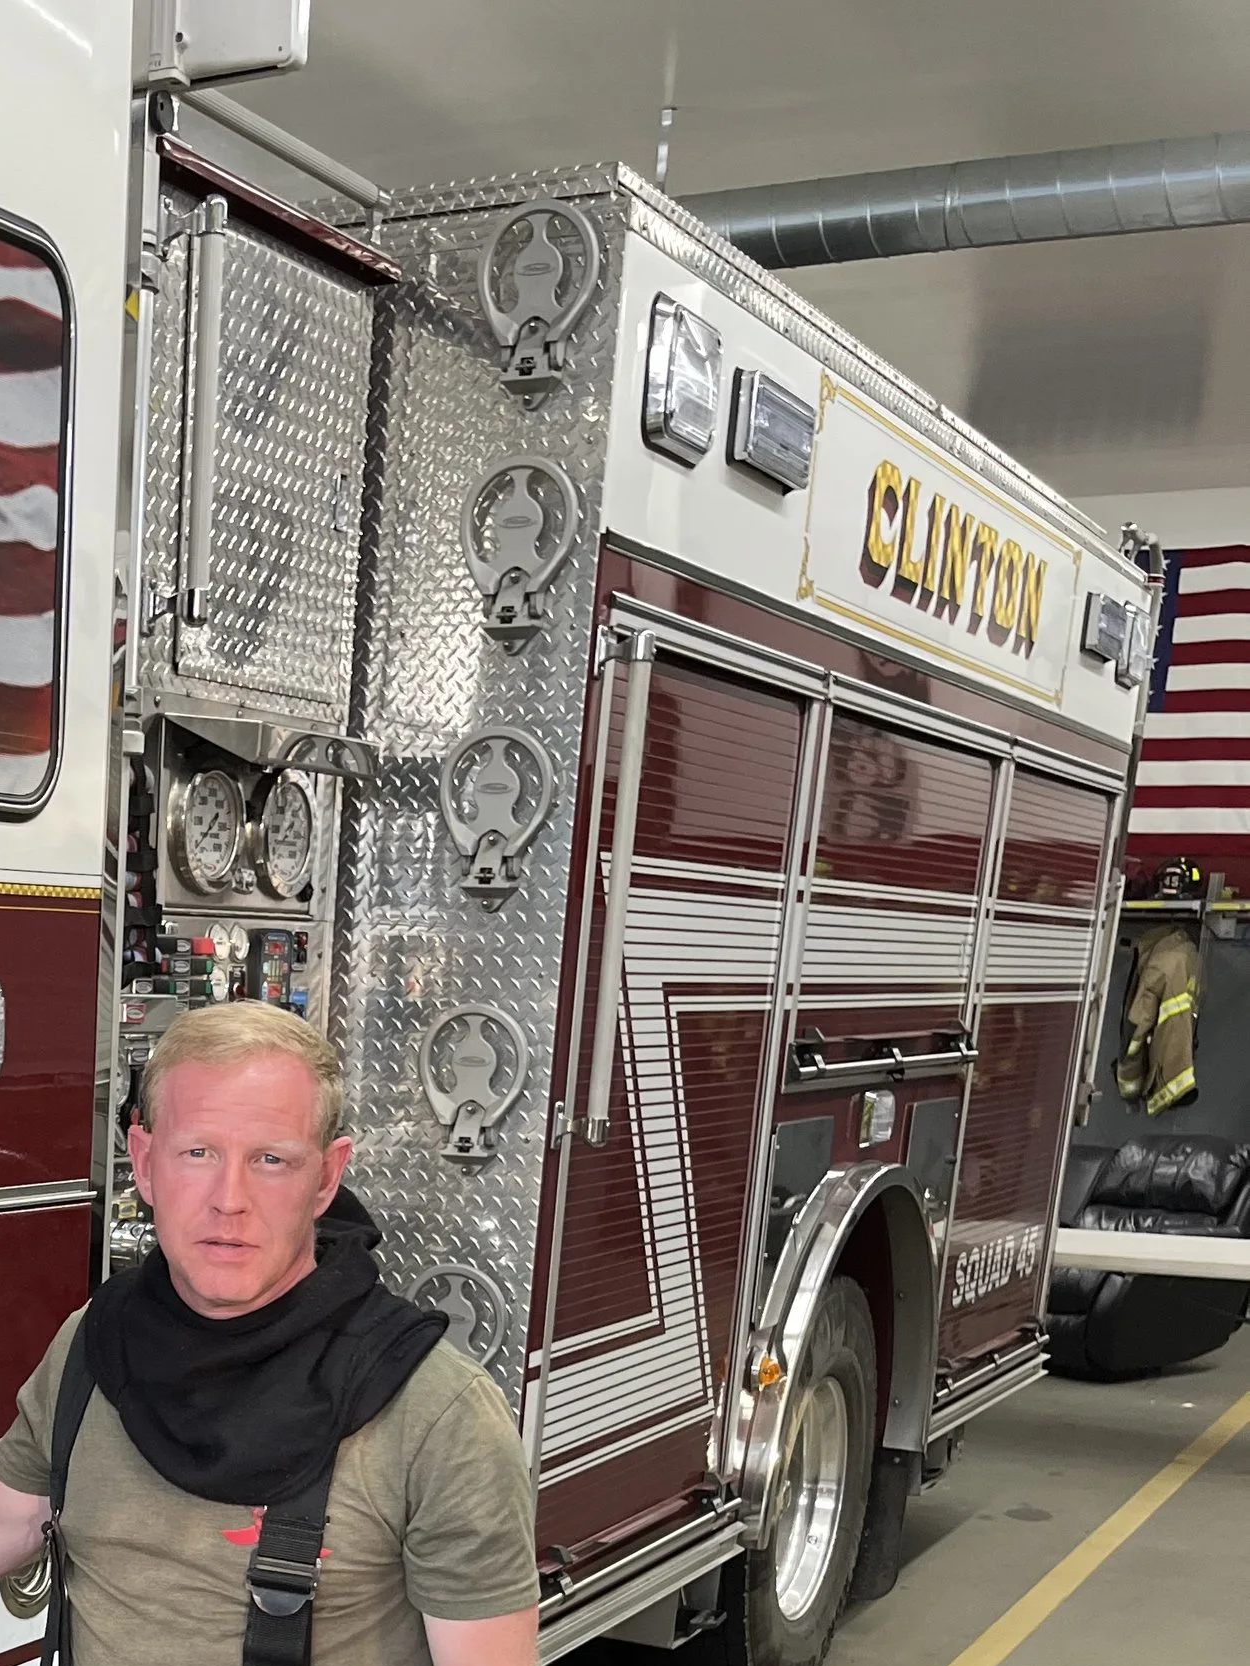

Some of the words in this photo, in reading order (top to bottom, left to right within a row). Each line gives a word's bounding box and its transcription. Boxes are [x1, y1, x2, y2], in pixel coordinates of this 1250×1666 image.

[865, 459, 1048, 646] CLINTON
[952, 1235, 1015, 1308] SQUAD
[1015, 1225, 1039, 1279] 45
